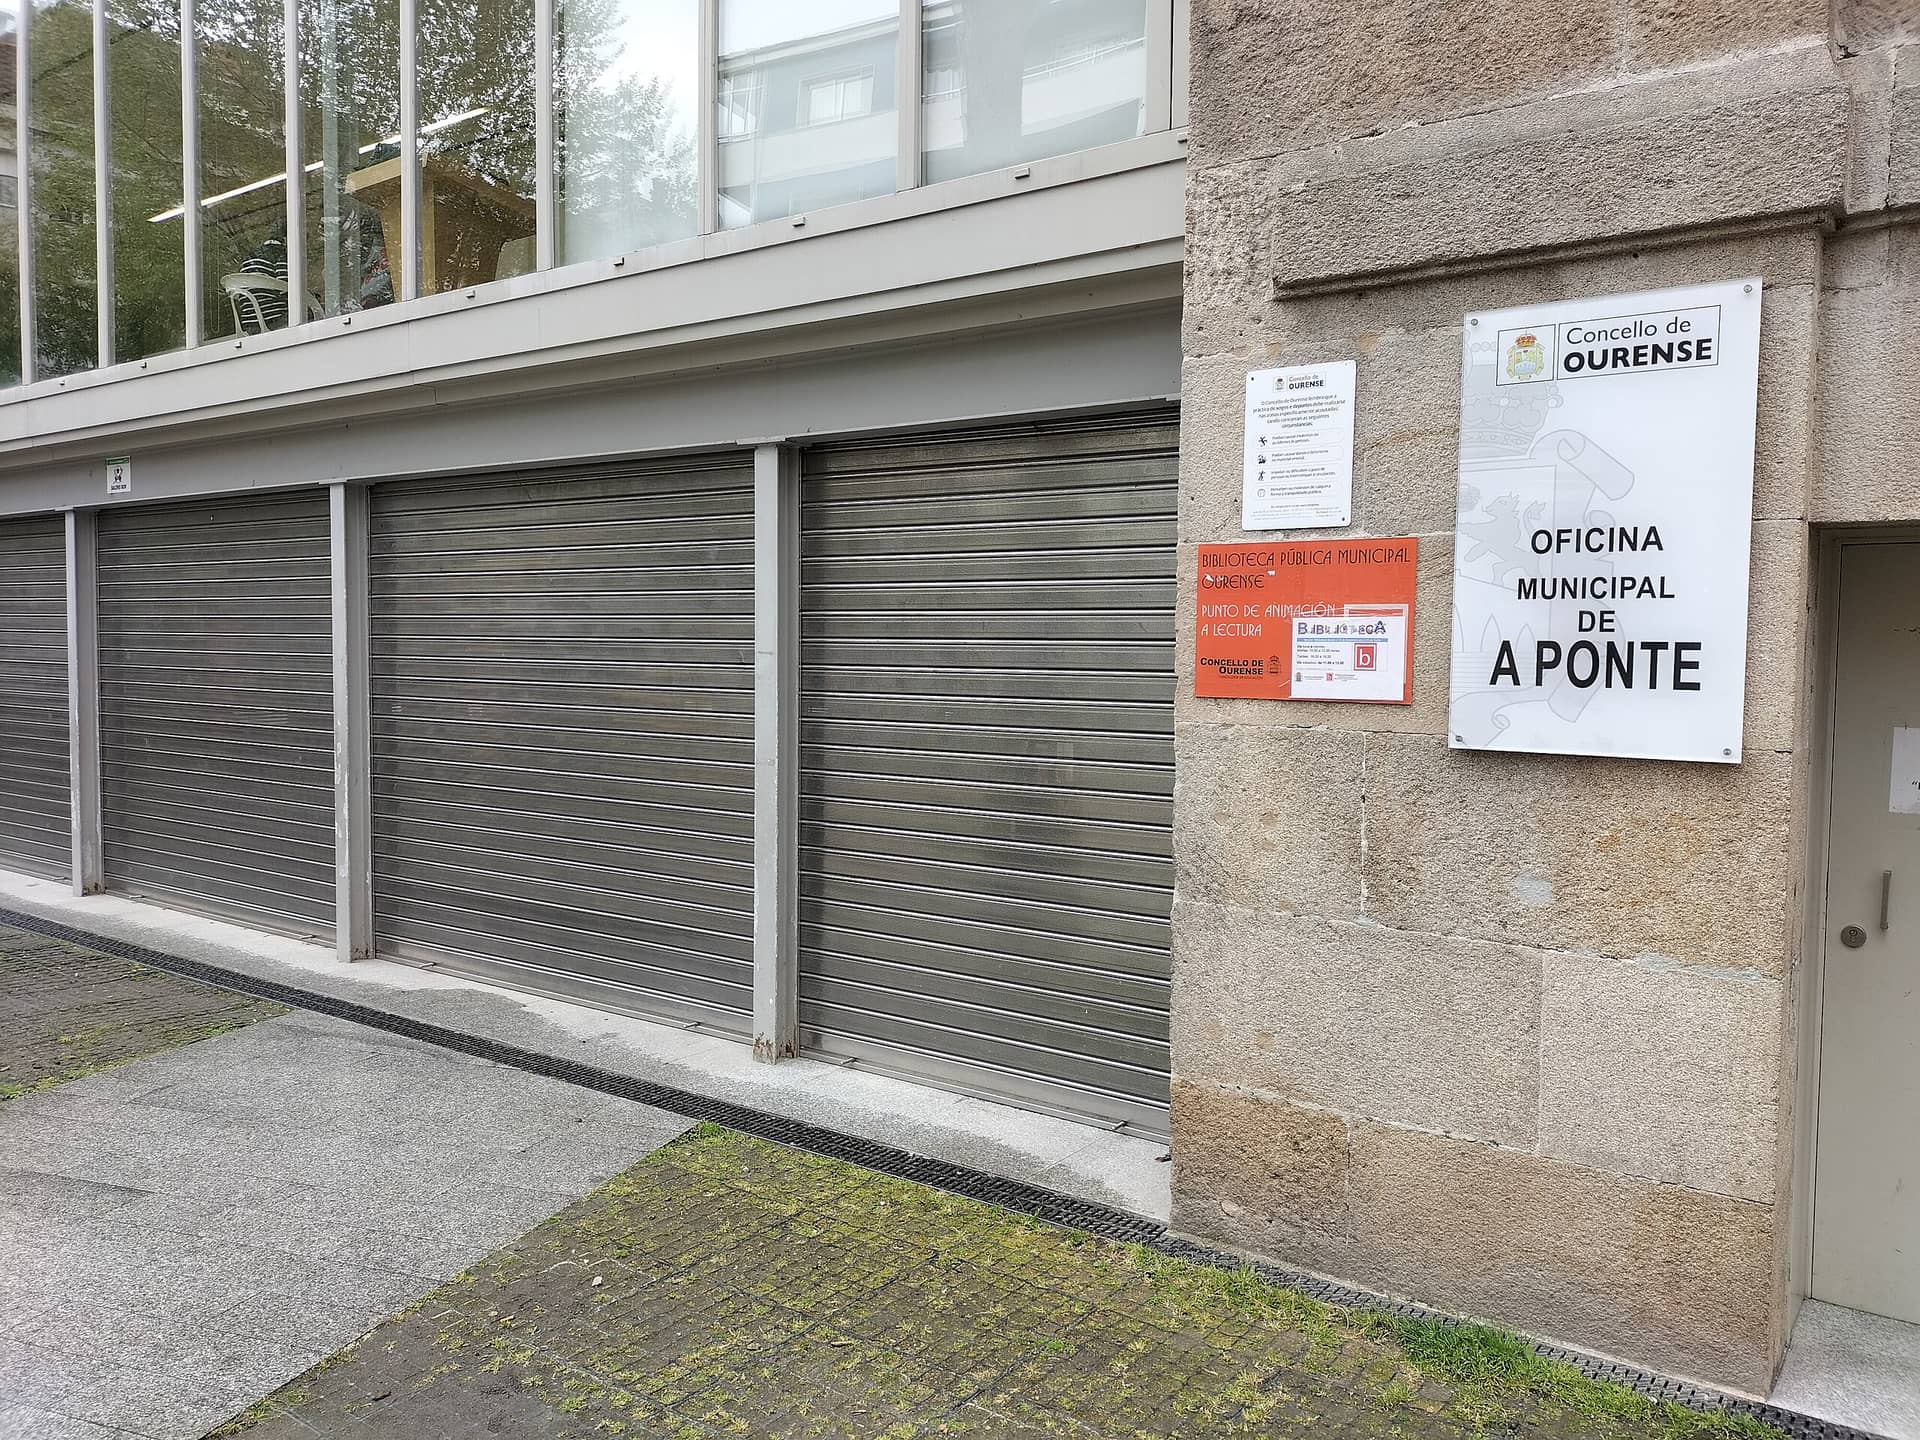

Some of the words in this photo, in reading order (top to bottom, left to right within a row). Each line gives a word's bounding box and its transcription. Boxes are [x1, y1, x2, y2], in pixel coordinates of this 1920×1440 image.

[1567, 319, 1658, 345] Concello
[1666, 316, 1691, 334] de
[1563, 338, 1713, 373] OURENSE
[1288, 374, 1311, 383] Concello
[1288, 380, 1325, 390] OURENSE
[1531, 526, 1664, 554] OFICINA
[1202, 552, 1275, 568] BIBLIOTECA
[1280, 548, 1332, 566] PÚBLICA
[1338, 548, 1411, 565] MUNICIPAL
[1201, 573, 1265, 589] OURENSE
[1517, 576, 1675, 600] MUNICIPAL
[1201, 604, 1240, 617] PUNTO
[1243, 604, 1260, 617] DE
[1264, 601, 1336, 617] ANIMACIÓN
[1200, 624, 1209, 637] A
[1213, 623, 1262, 637] LECTURA
[1578, 610, 1616, 633] DE
[1251, 659, 1264, 667] DE
[1489, 640, 1521, 686] A
[1535, 640, 1702, 691] PONTE
